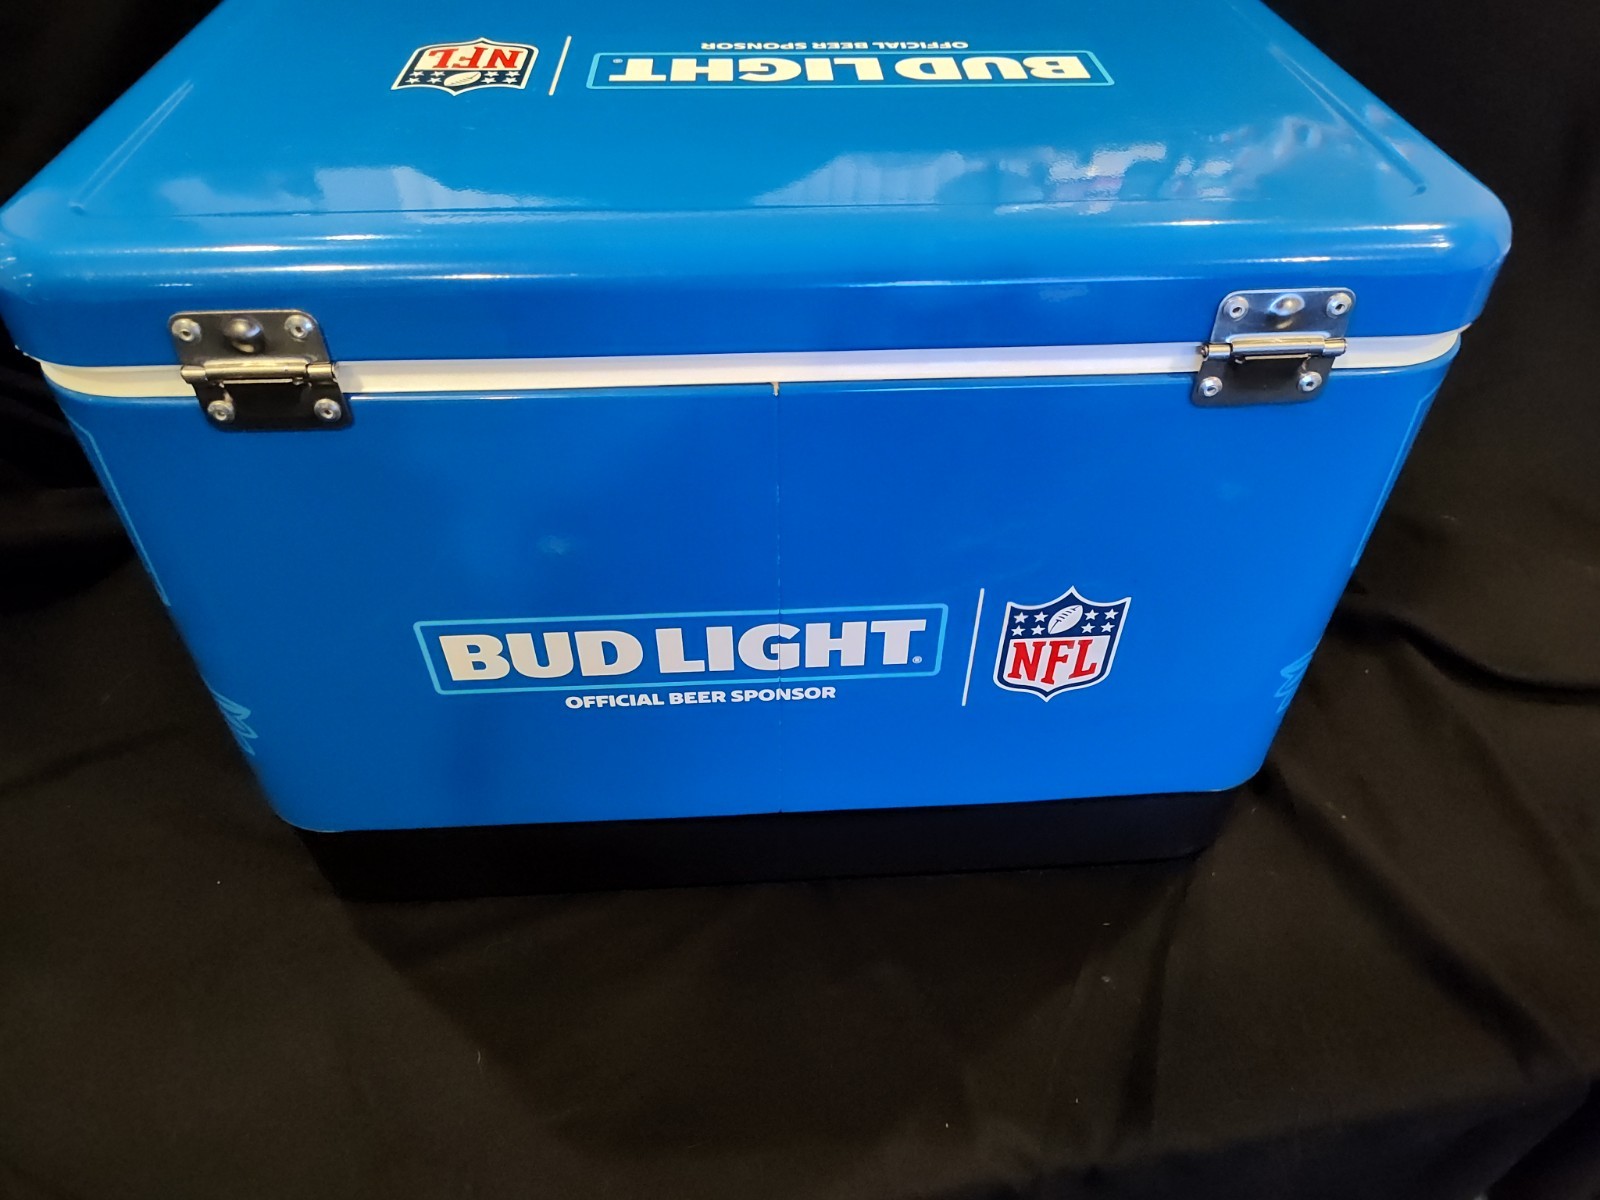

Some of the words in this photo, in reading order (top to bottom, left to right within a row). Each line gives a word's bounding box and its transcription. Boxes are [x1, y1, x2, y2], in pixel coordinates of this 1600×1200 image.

[700, 42, 808, 50] SPONSOR
[812, 42, 868, 50] BEER
[871, 41, 969, 49] OFFICIAL
[428, 46, 522, 69] NFL
[894, 55, 1092, 81] BUD
[438, 630, 643, 682] BUD
[1007, 638, 1098, 685] NFL
[565, 693, 665, 709] OFFICIAL
[669, 690, 727, 706] BEER
[731, 686, 836, 703] SPONSOR
